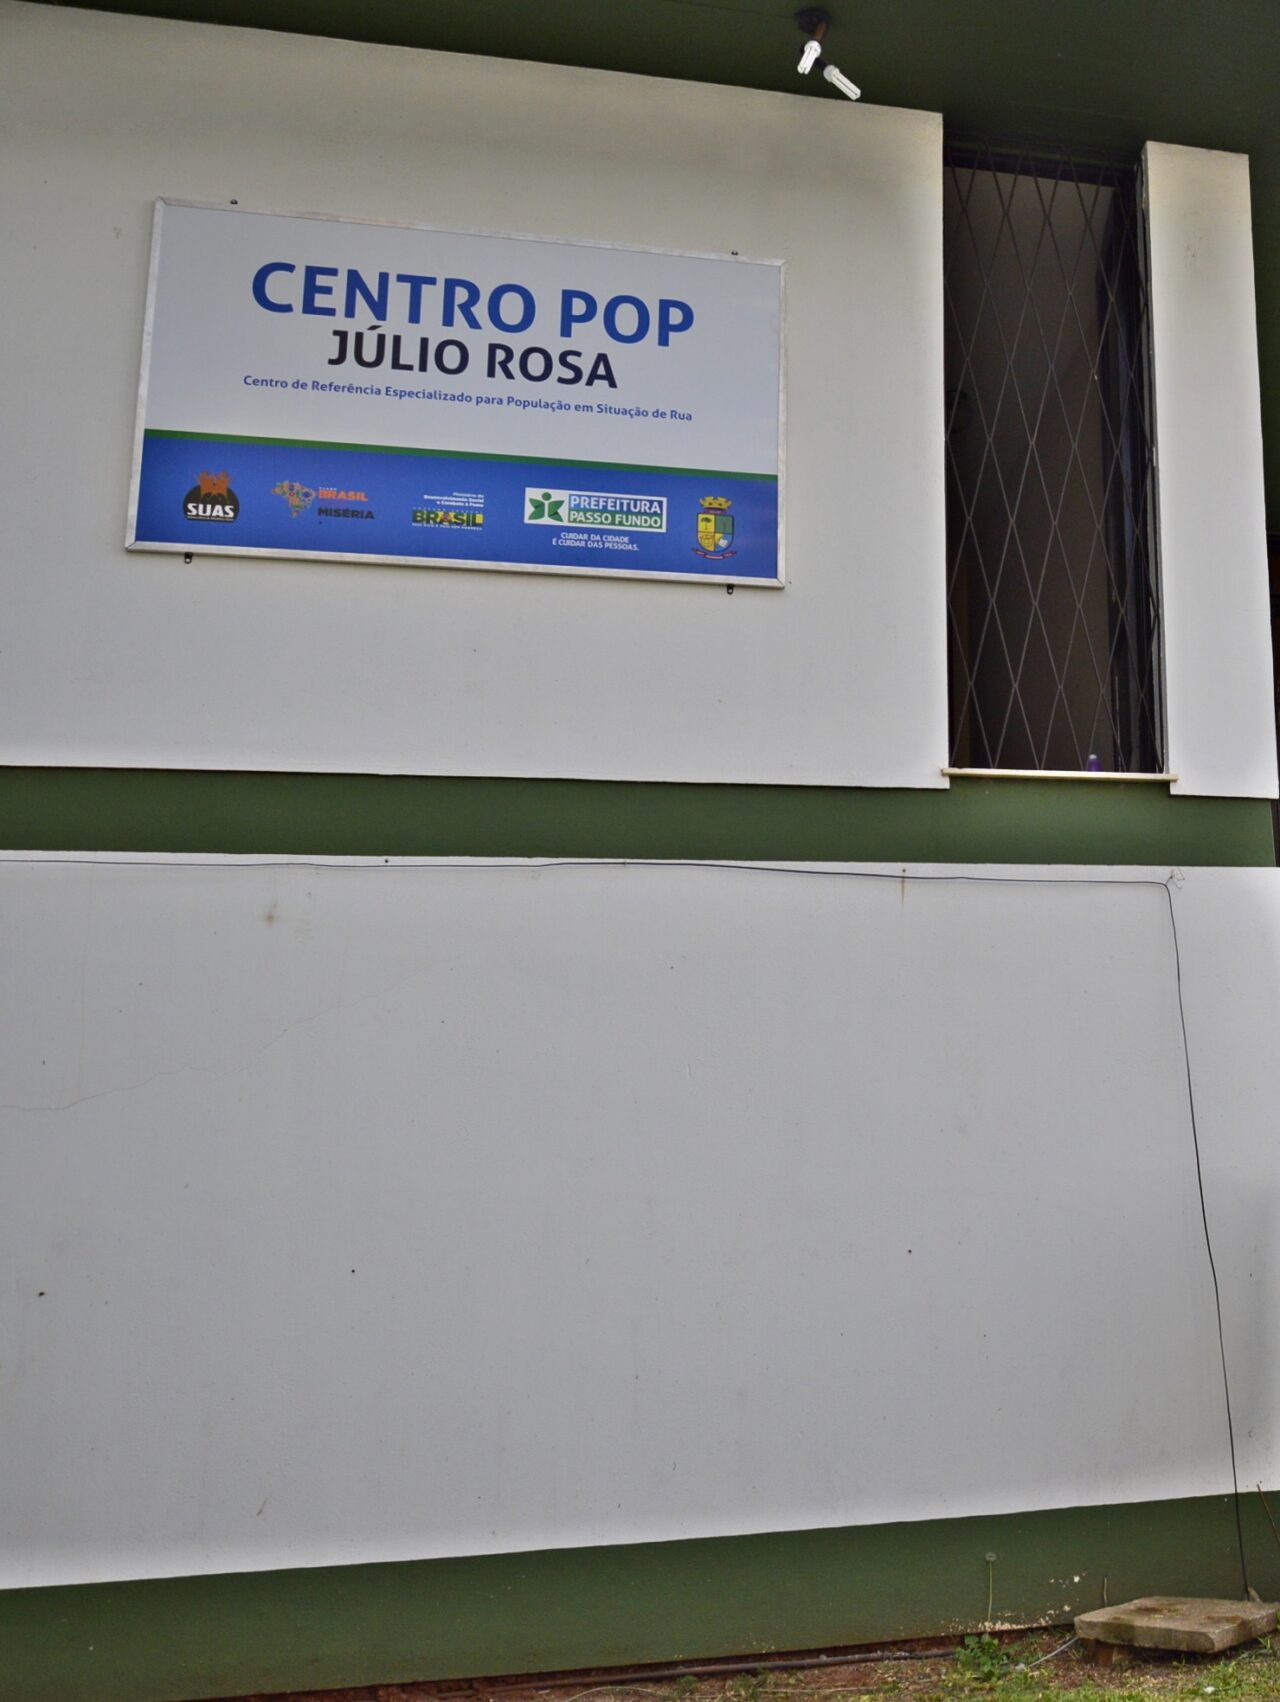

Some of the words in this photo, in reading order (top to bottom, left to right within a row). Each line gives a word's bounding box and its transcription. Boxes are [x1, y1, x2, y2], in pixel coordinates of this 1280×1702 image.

[252, 261, 537, 334] CENTRO
[559, 288, 695, 347] POP
[327, 325, 470, 376] JÚLIO
[486, 342, 618, 389] ROSA
[243, 375, 288, 389] Centro
[291, 379, 308, 390] de
[311, 380, 382, 396] Referência
[385, 386, 473, 404] Especializado
[475, 394, 503, 406] para
[507, 396, 571, 412] População
[574, 403, 594, 413] em
[596, 403, 649, 419] Situação
[652, 408, 667, 419] de
[670, 410, 693, 421] Rua
[319, 489, 369, 502] BRASIL
[186, 502, 235, 518] SUAS
[570, 495, 661, 514] PREFEITURA
[412, 510, 484, 526] BRASIL
[569, 510, 612, 524] PASSO
[615, 514, 661, 528] FUNDO
[558, 539, 586, 548] CUIDAR
[587, 540, 603, 549] DAS
[560, 532, 589, 541] CUIDAR
[602, 534, 630, 543] CIDADE
